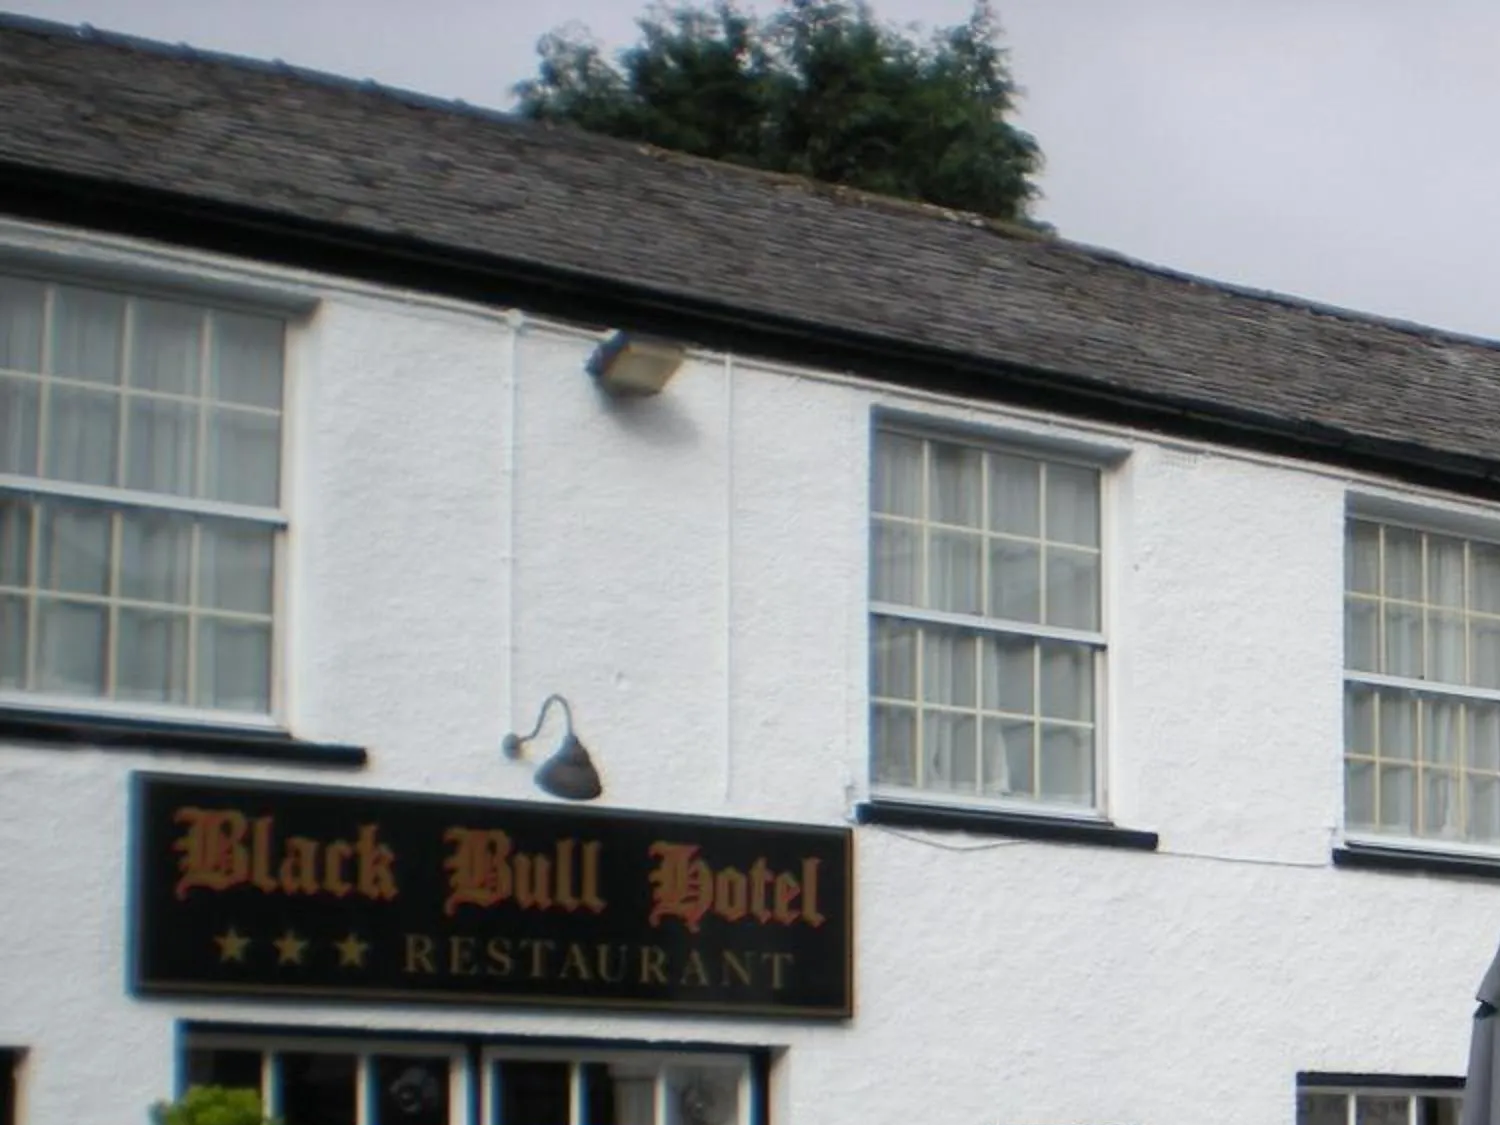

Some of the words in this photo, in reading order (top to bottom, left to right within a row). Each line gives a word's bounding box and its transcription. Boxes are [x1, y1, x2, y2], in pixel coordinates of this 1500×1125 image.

[172, 806, 398, 900] Black
[443, 827, 608, 916] Bull
[648, 840, 826, 932] Hotel
[404, 932, 795, 990] RESTAURANT
